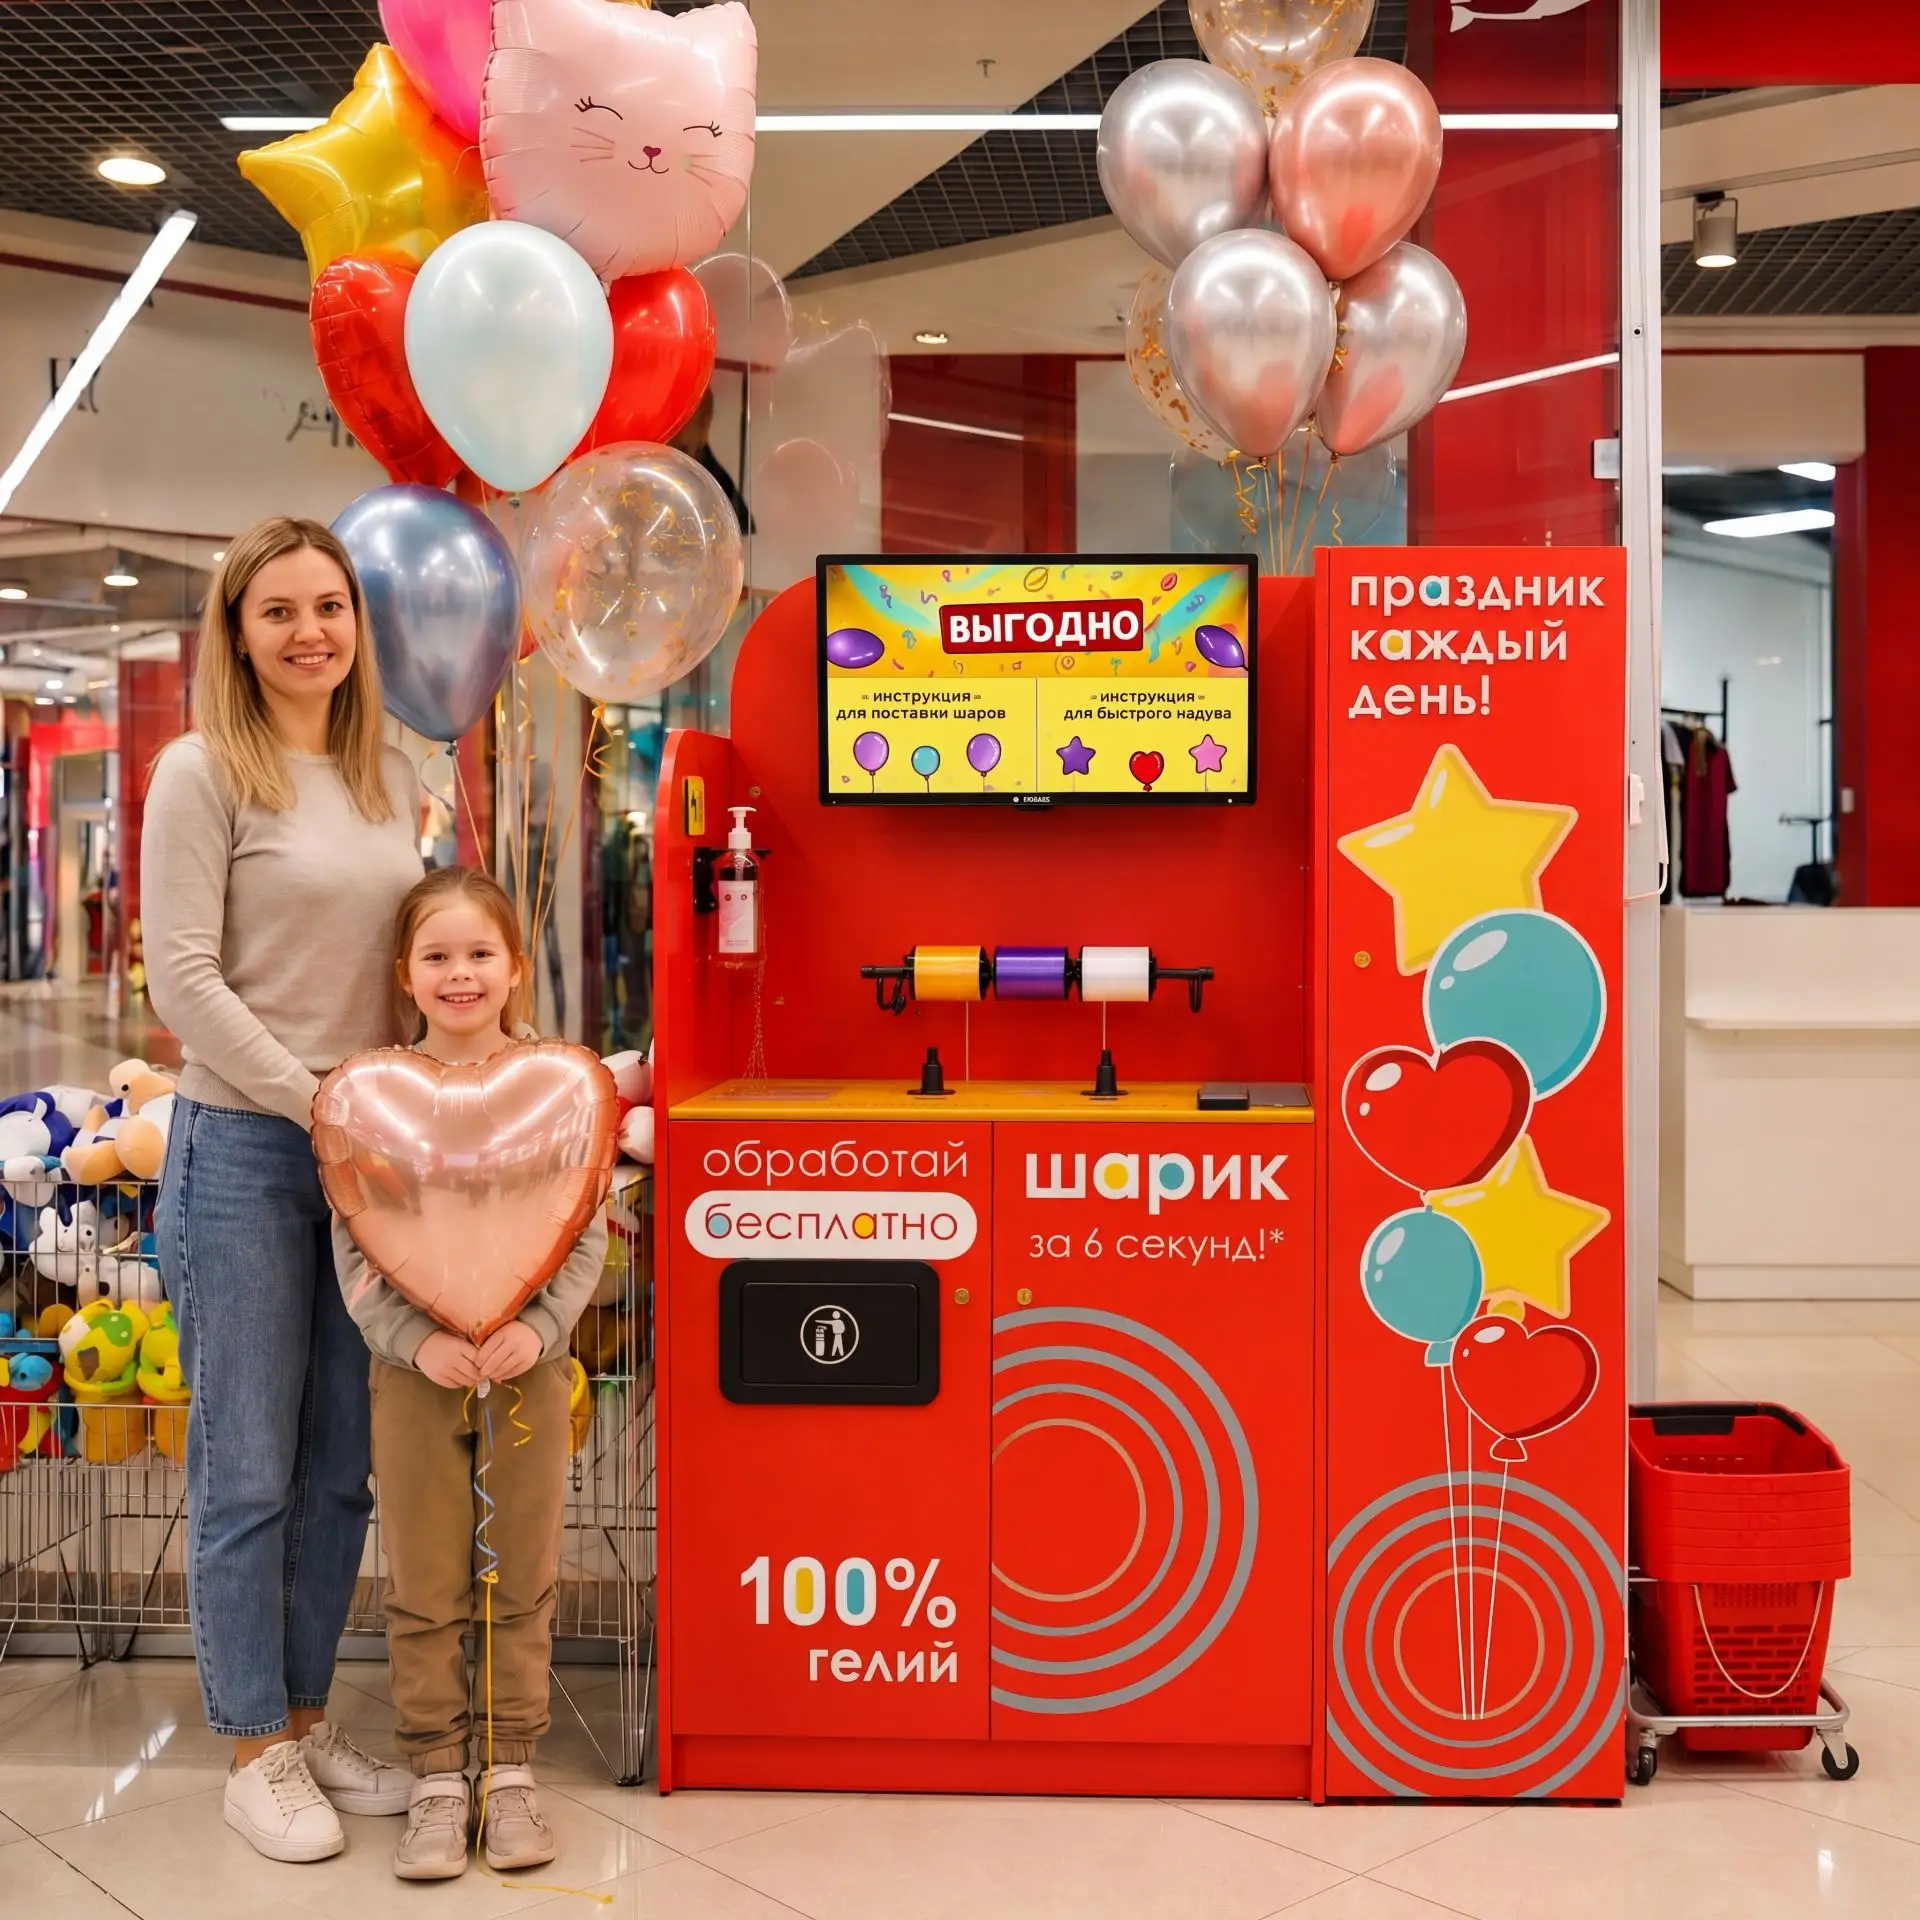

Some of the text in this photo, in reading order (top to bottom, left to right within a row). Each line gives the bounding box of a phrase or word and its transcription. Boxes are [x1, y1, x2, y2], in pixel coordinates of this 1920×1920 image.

[1350, 575, 1605, 616] праздник
[949, 610, 1140, 647] ВЫГОДНО
[1351, 619, 1567, 664] каждый
[836, 709, 1006, 722] для поставки шаров
[873, 692, 971, 705] инструкция
[1063, 707, 1232, 722] для быстрого надува
[1100, 692, 1195, 705] инструкция
[1348, 675, 1491, 718] день!
[703, 1139, 967, 1186] обработай
[1025, 1152, 1290, 1215] шарик
[704, 1203, 958, 1241] бесплатно
[1029, 1234, 1071, 1258] за
[1084, 1227, 1103, 1258] 6
[740, 1555, 957, 1629] 100%
[809, 1640, 958, 1683] гелий
